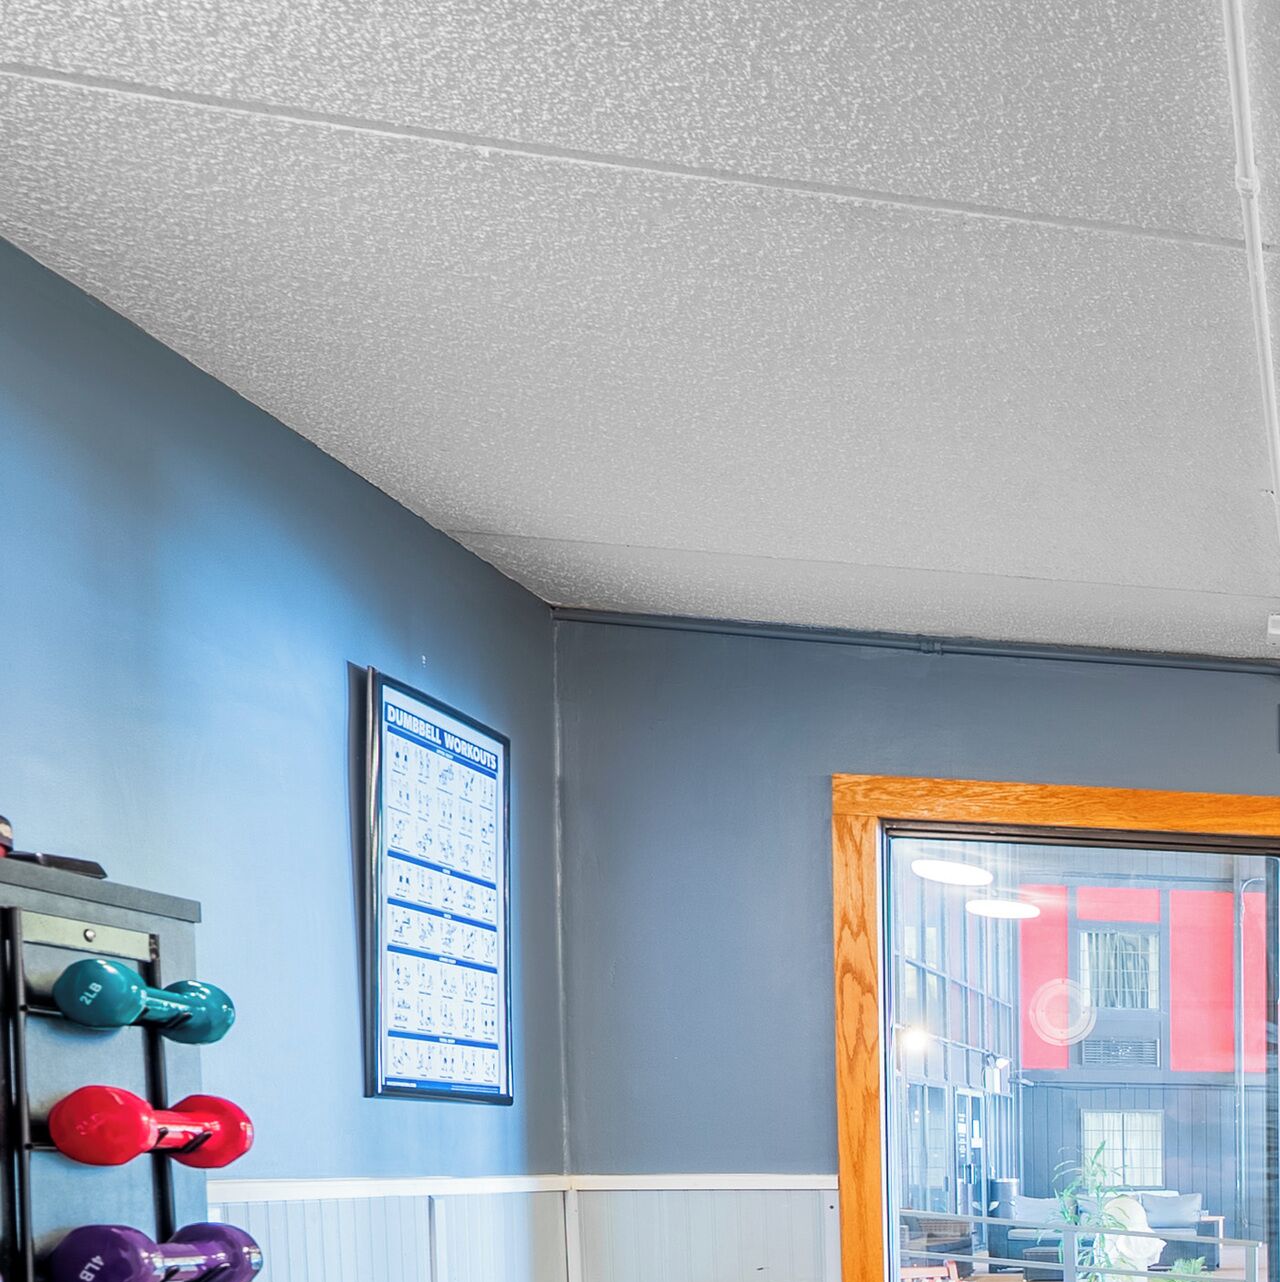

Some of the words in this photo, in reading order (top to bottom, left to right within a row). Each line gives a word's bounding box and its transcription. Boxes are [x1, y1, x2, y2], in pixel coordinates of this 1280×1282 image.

[387, 704, 441, 745] DUMBBELL
[444, 732, 497, 770] WORKOUTS
[80, 982, 102, 1006] 2LB
[80, 1256, 104, 1282] 4LB
